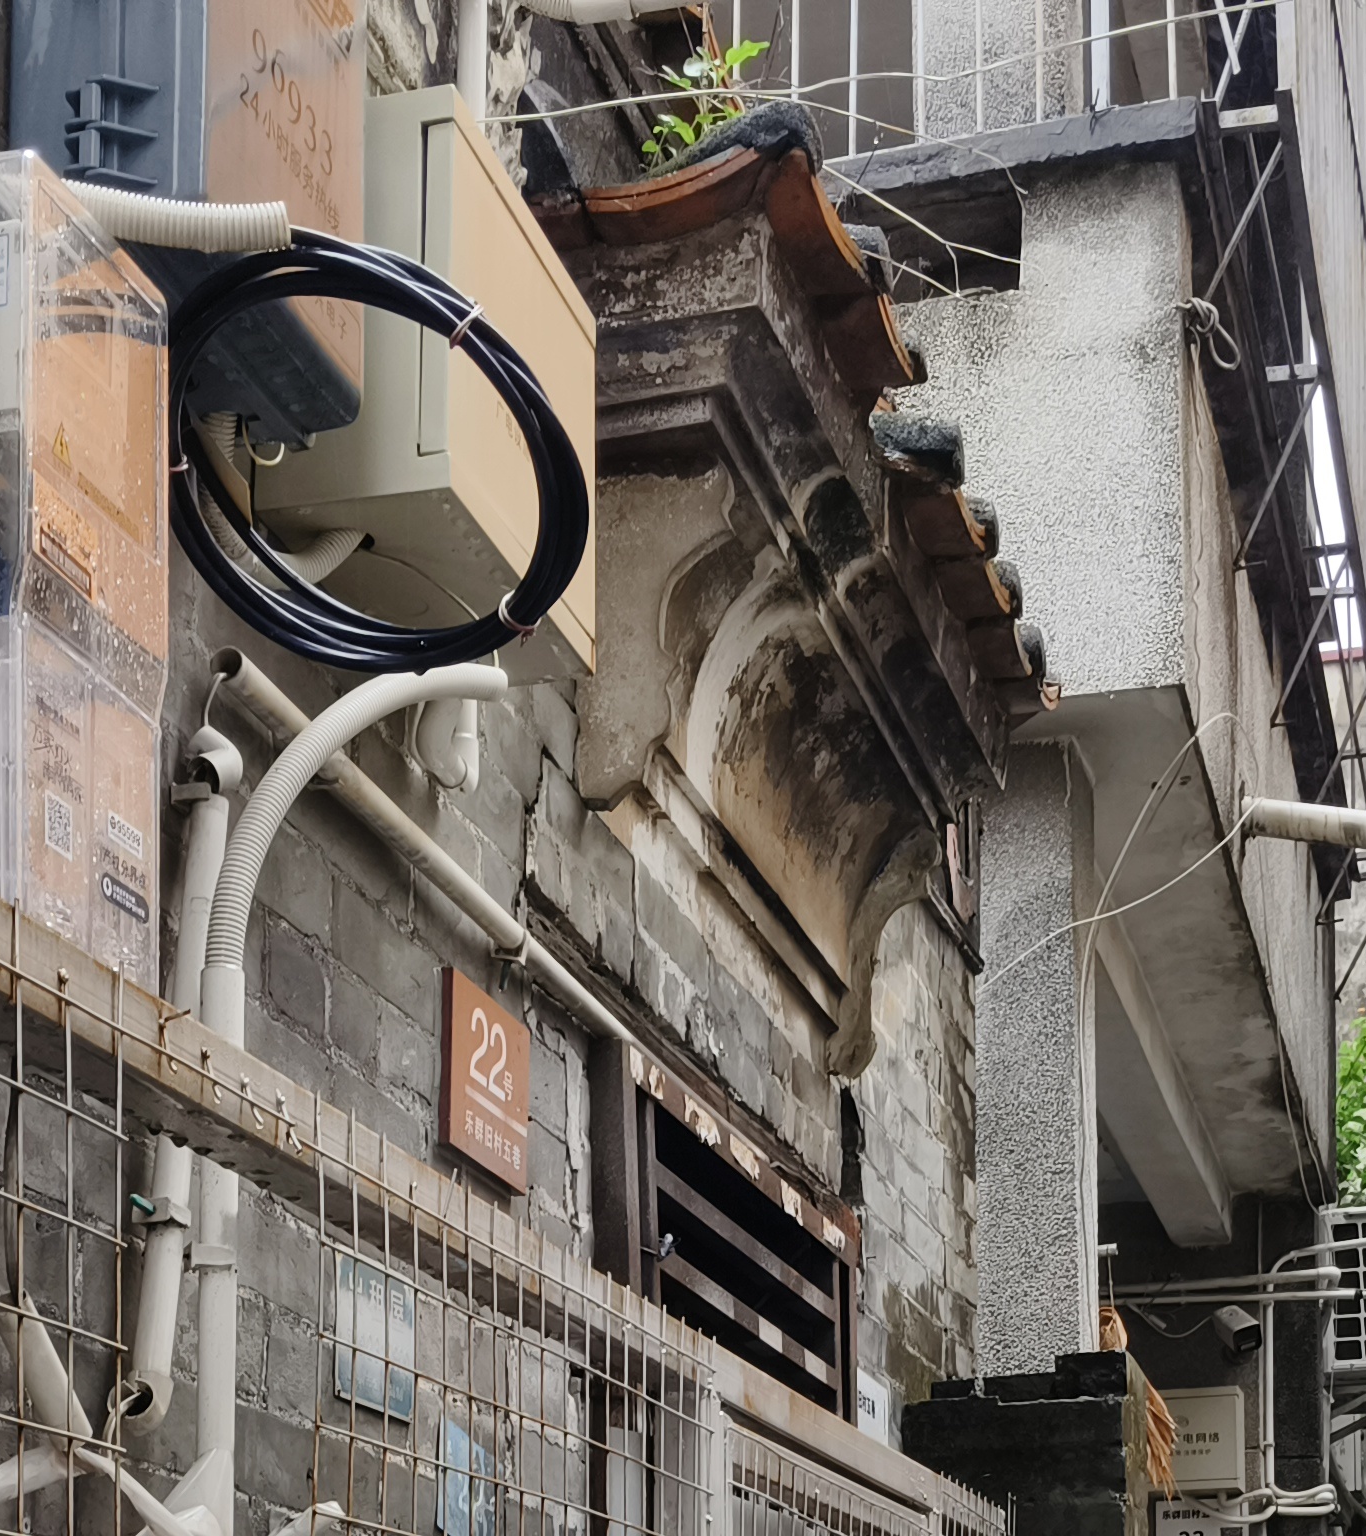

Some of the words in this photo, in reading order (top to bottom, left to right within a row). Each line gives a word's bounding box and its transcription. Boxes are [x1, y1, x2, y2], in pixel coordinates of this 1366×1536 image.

[252, 28, 333, 176] 96933
[469, 1007, 513, 1102] 22号
[464, 1109, 522, 1171] 乐群旧村五巷
